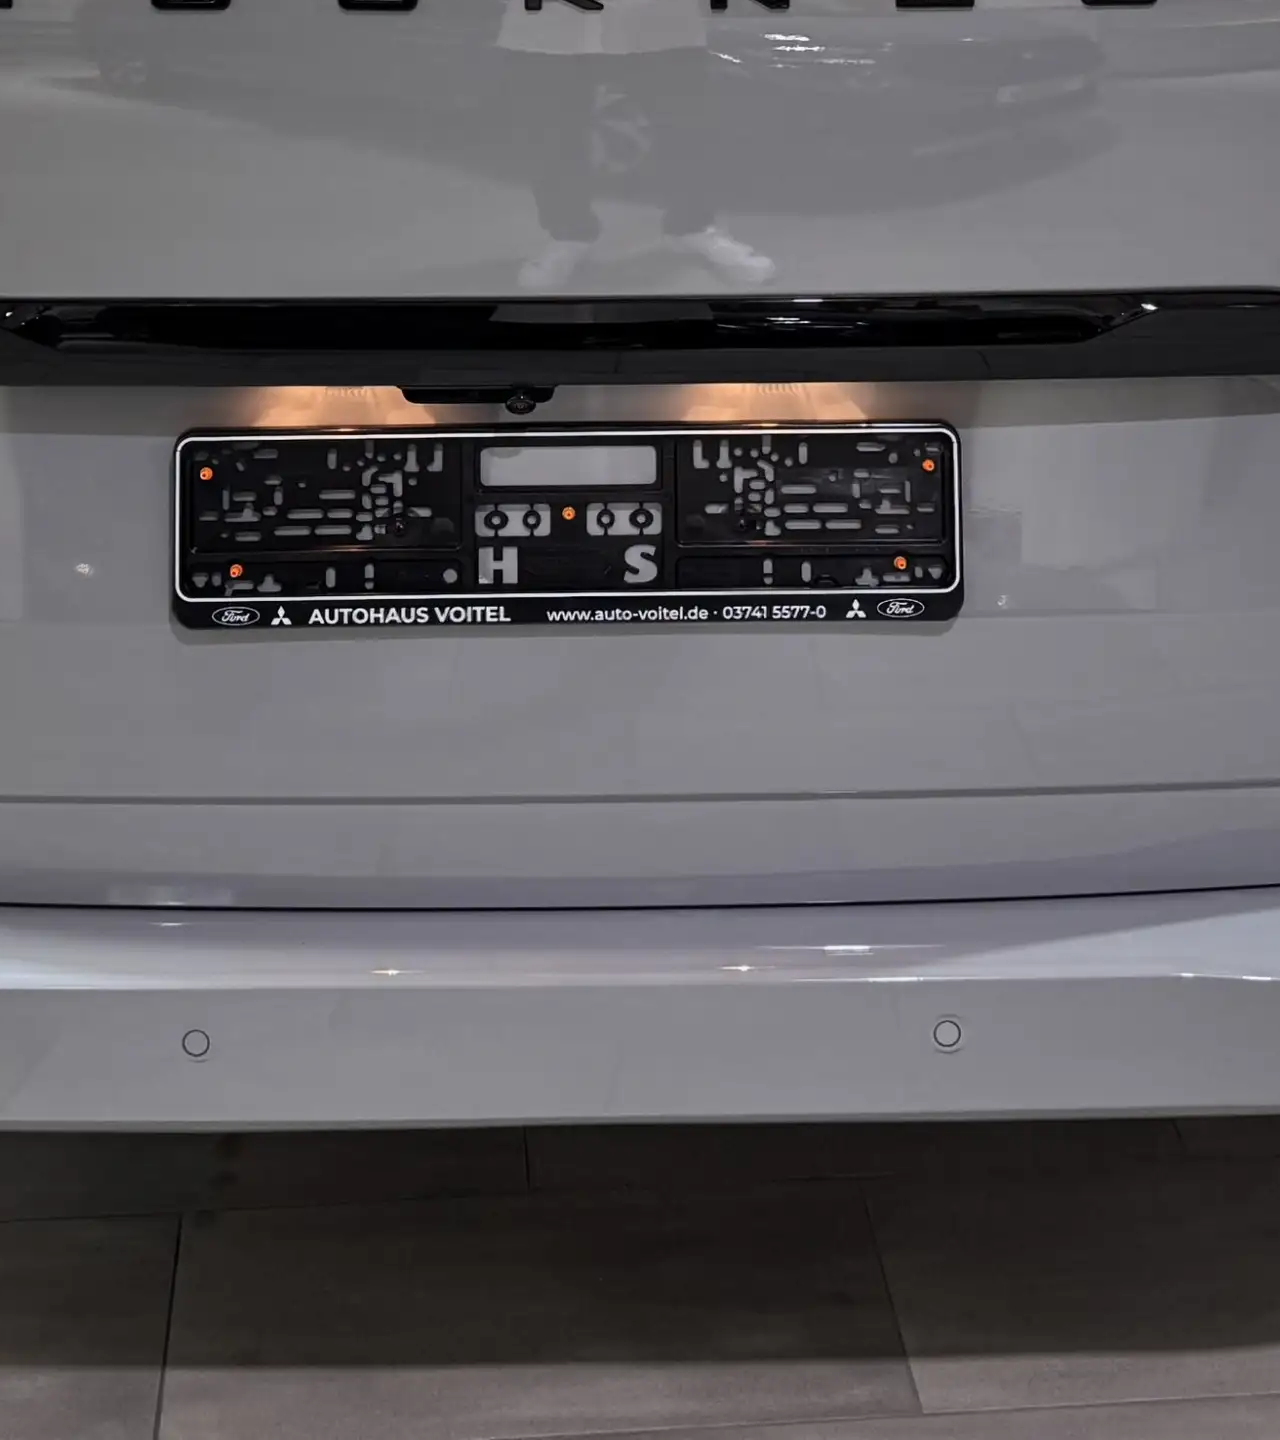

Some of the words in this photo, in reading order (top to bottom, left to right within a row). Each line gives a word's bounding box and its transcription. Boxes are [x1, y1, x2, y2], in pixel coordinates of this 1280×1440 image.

[308, 607, 430, 625] AUTOHAUS
[434, 605, 511, 623] VOITEL
[546, 605, 709, 622] www.auto-voitel.de
[722, 604, 767, 620] 03741
[771, 604, 827, 620] 5577-0
